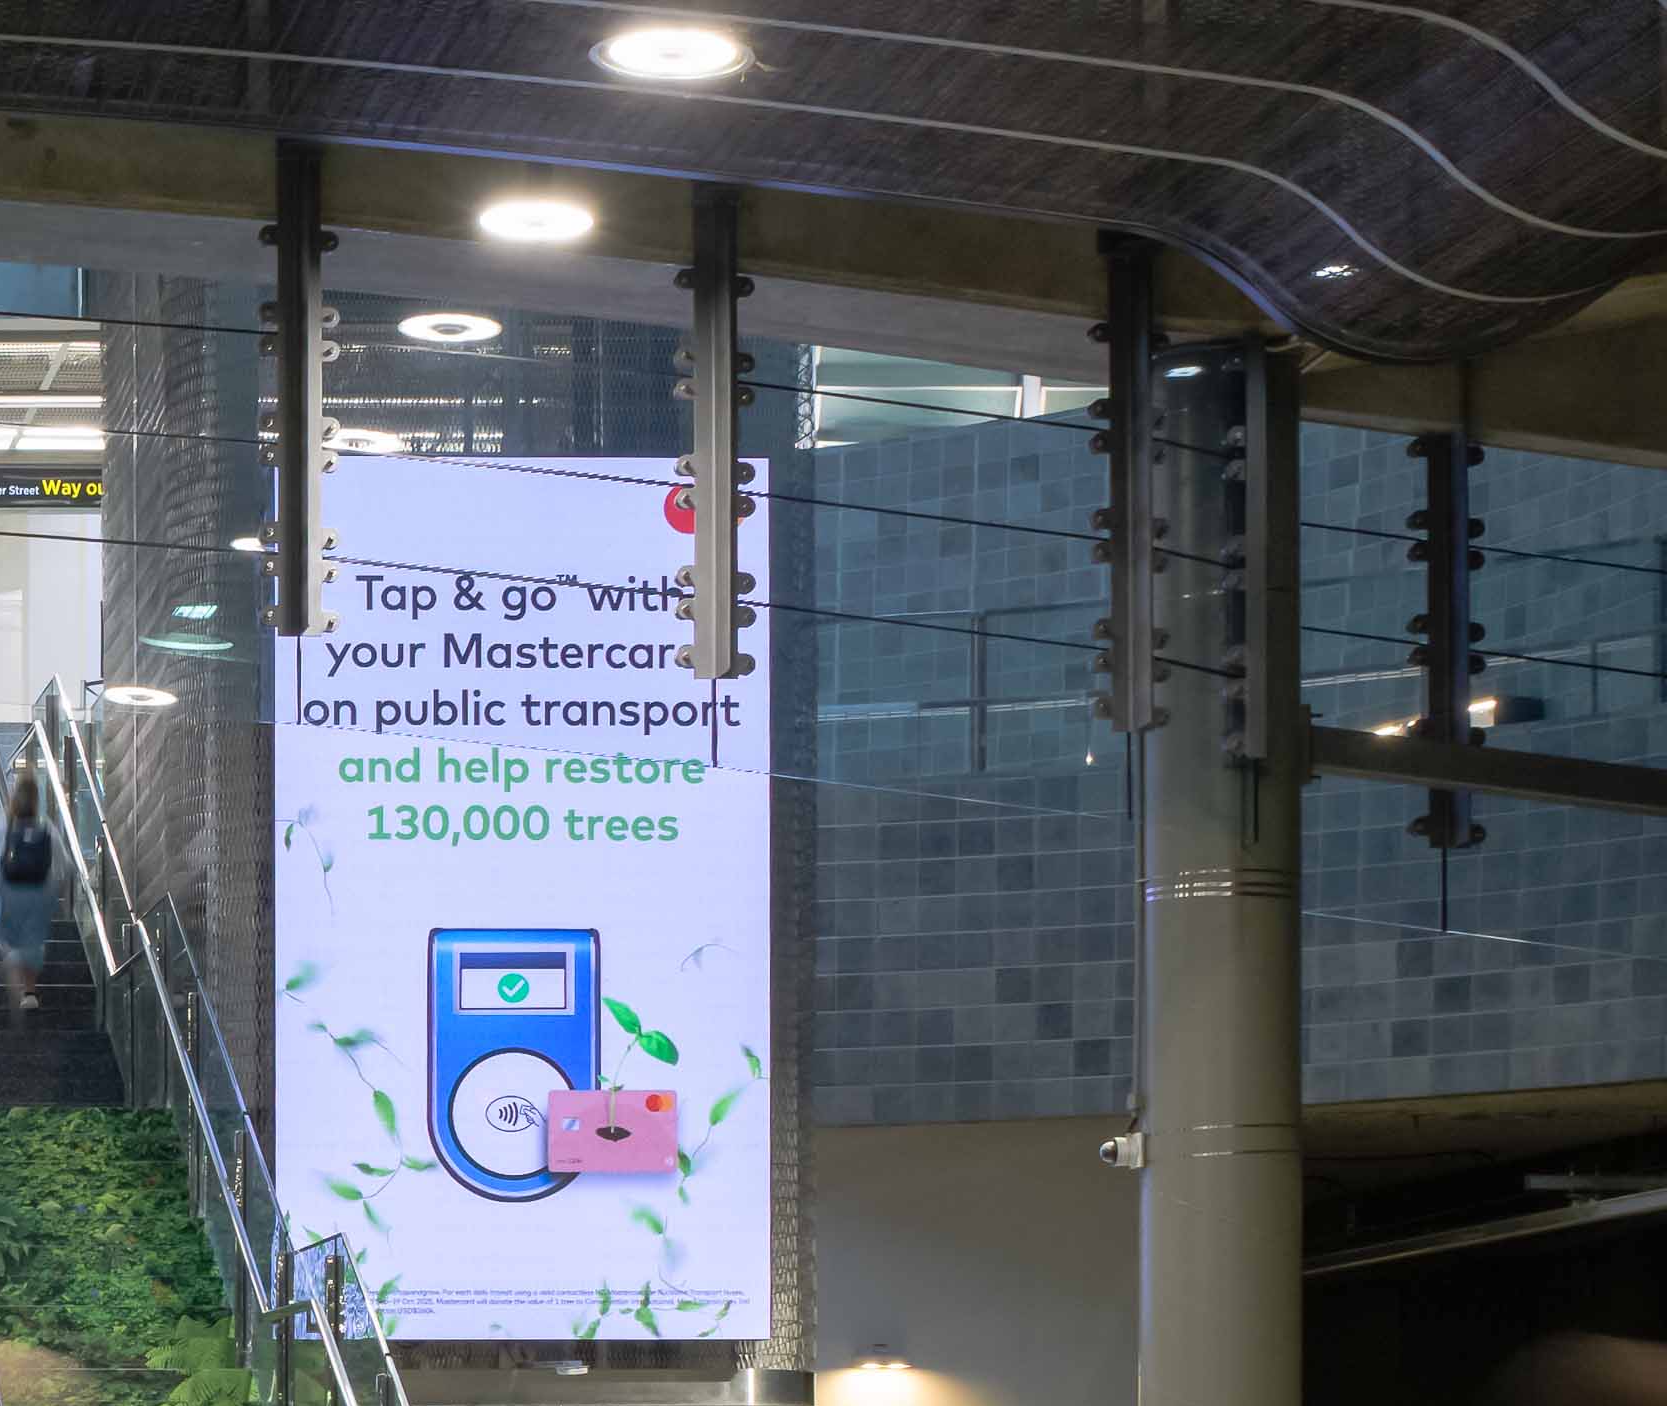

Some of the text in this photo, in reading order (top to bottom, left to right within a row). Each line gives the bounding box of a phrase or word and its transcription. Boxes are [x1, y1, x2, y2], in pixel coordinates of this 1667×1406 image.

[9, 485, 39, 496] Street
[42, 480, 83, 499] Way
[85, 483, 105, 496] ou
[355, 575, 437, 620] Tap
[453, 575, 486, 612] &
[325, 633, 677, 678] your Mastercar
[302, 690, 741, 736] on public transport
[339, 747, 706, 793] and help restore
[367, 804, 680, 847] 130,000 trees
